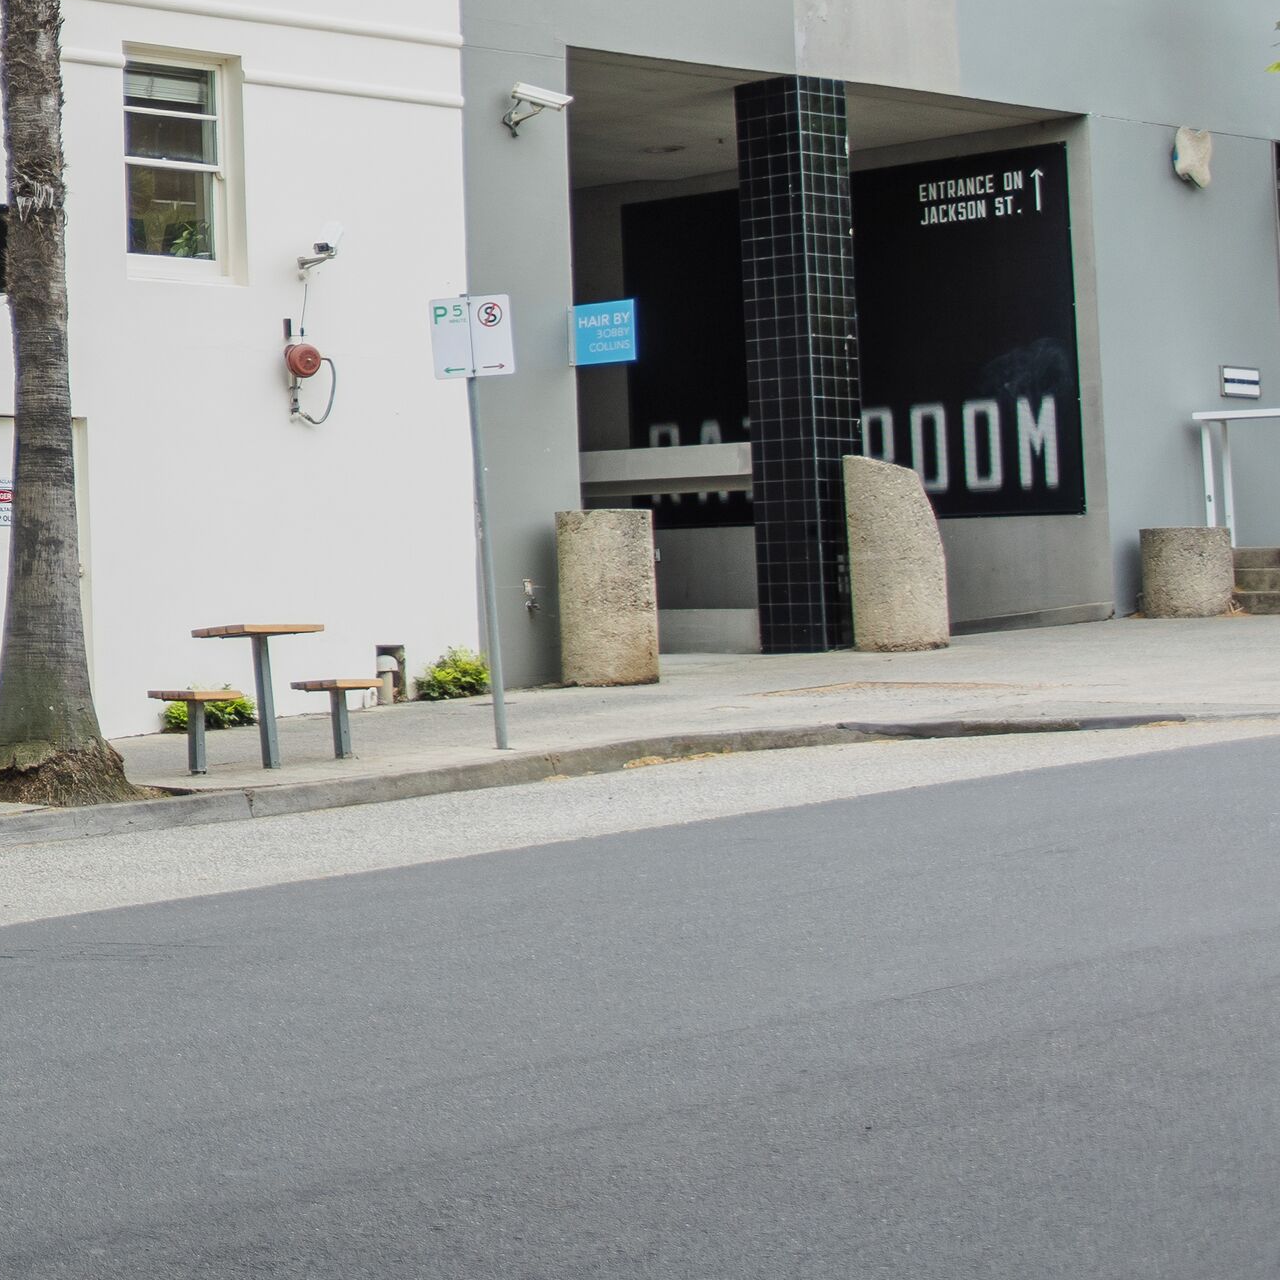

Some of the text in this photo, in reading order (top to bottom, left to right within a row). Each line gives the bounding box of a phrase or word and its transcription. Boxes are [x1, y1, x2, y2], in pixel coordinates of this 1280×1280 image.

[919, 170, 1023, 202] ENTRANCE ON
[920, 196, 1022, 226] JACKSON ST.
[433, 304, 463, 325] P 5
[578, 311, 630, 329] HAIR BY
[588, 339, 631, 353] COLLINS
